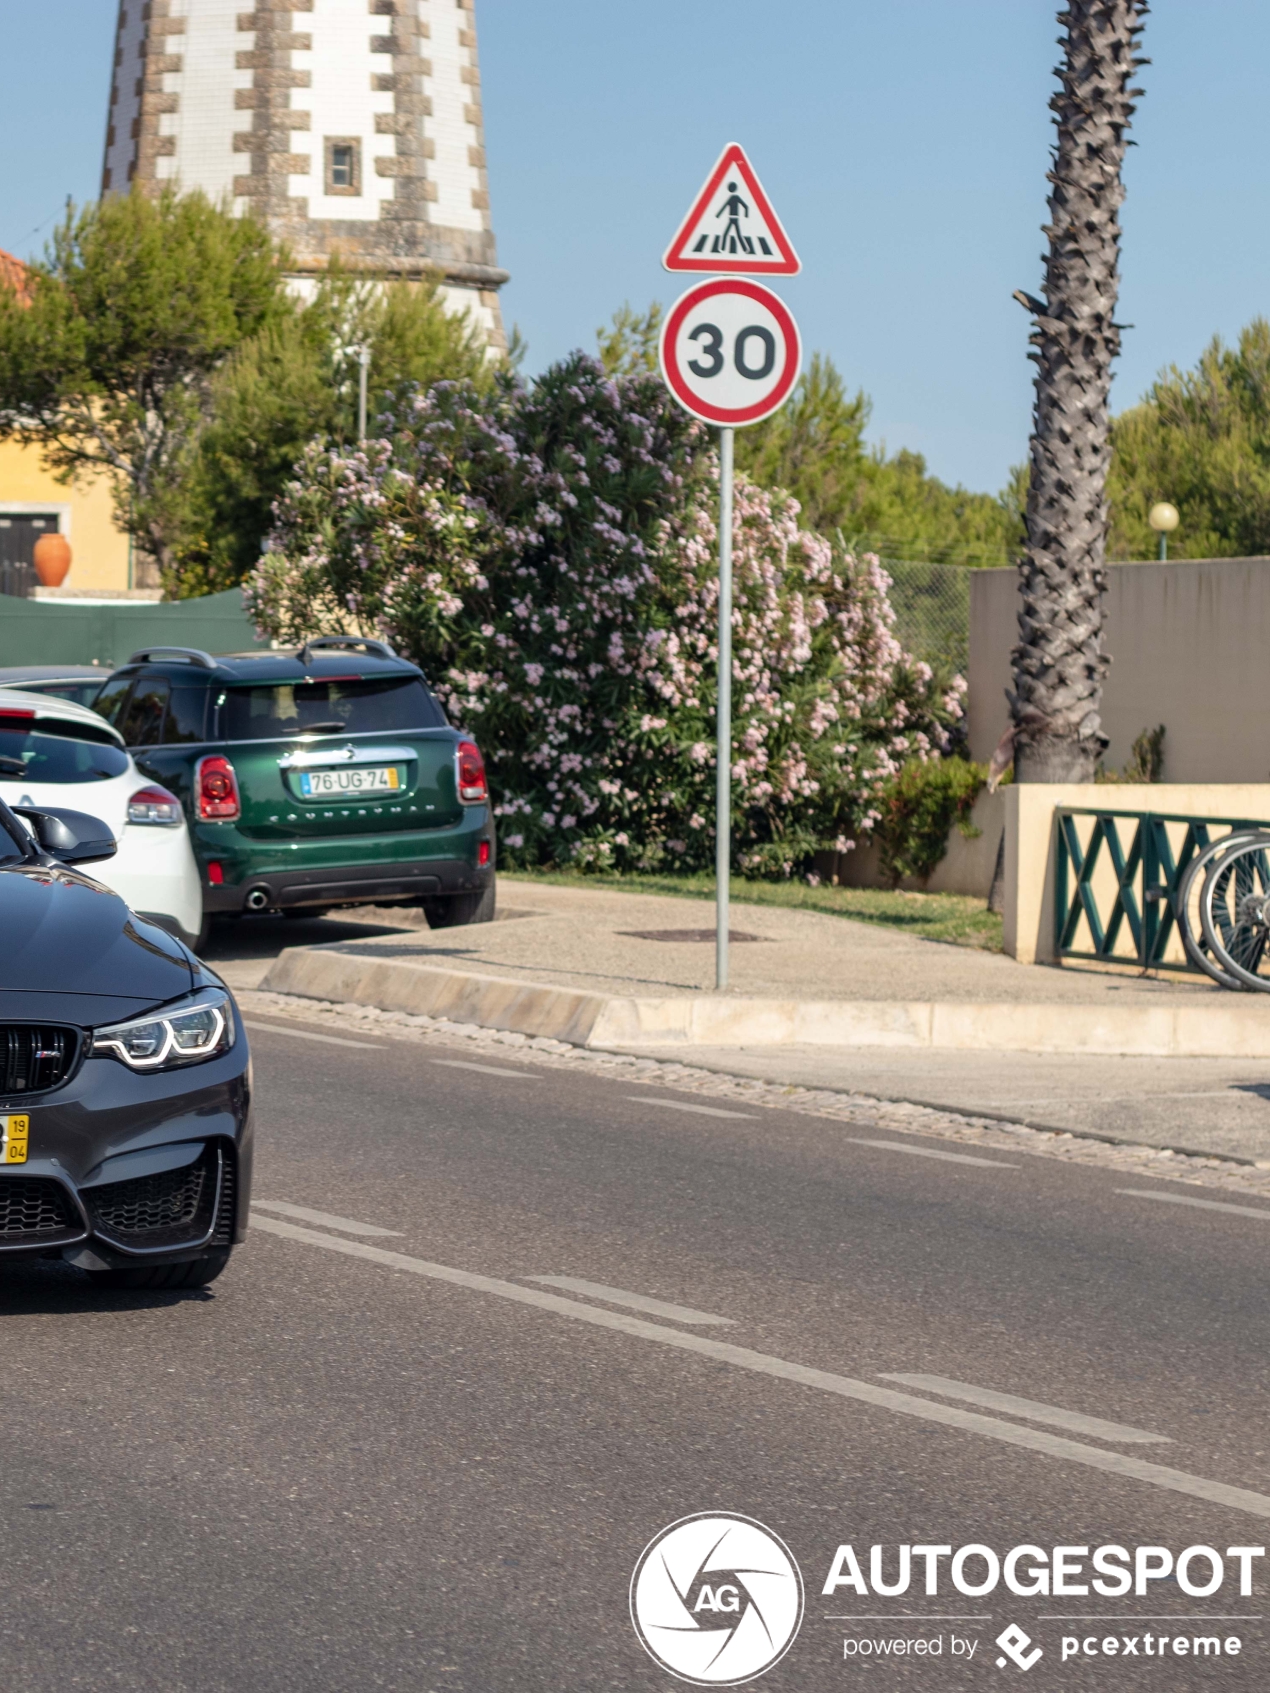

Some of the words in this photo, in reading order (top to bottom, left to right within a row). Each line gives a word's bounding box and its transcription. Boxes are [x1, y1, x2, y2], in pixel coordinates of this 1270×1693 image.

[687, 322, 776, 380] 30
[13, 1120, 26, 1133] 19
[10, 1145, 25, 1158] 04
